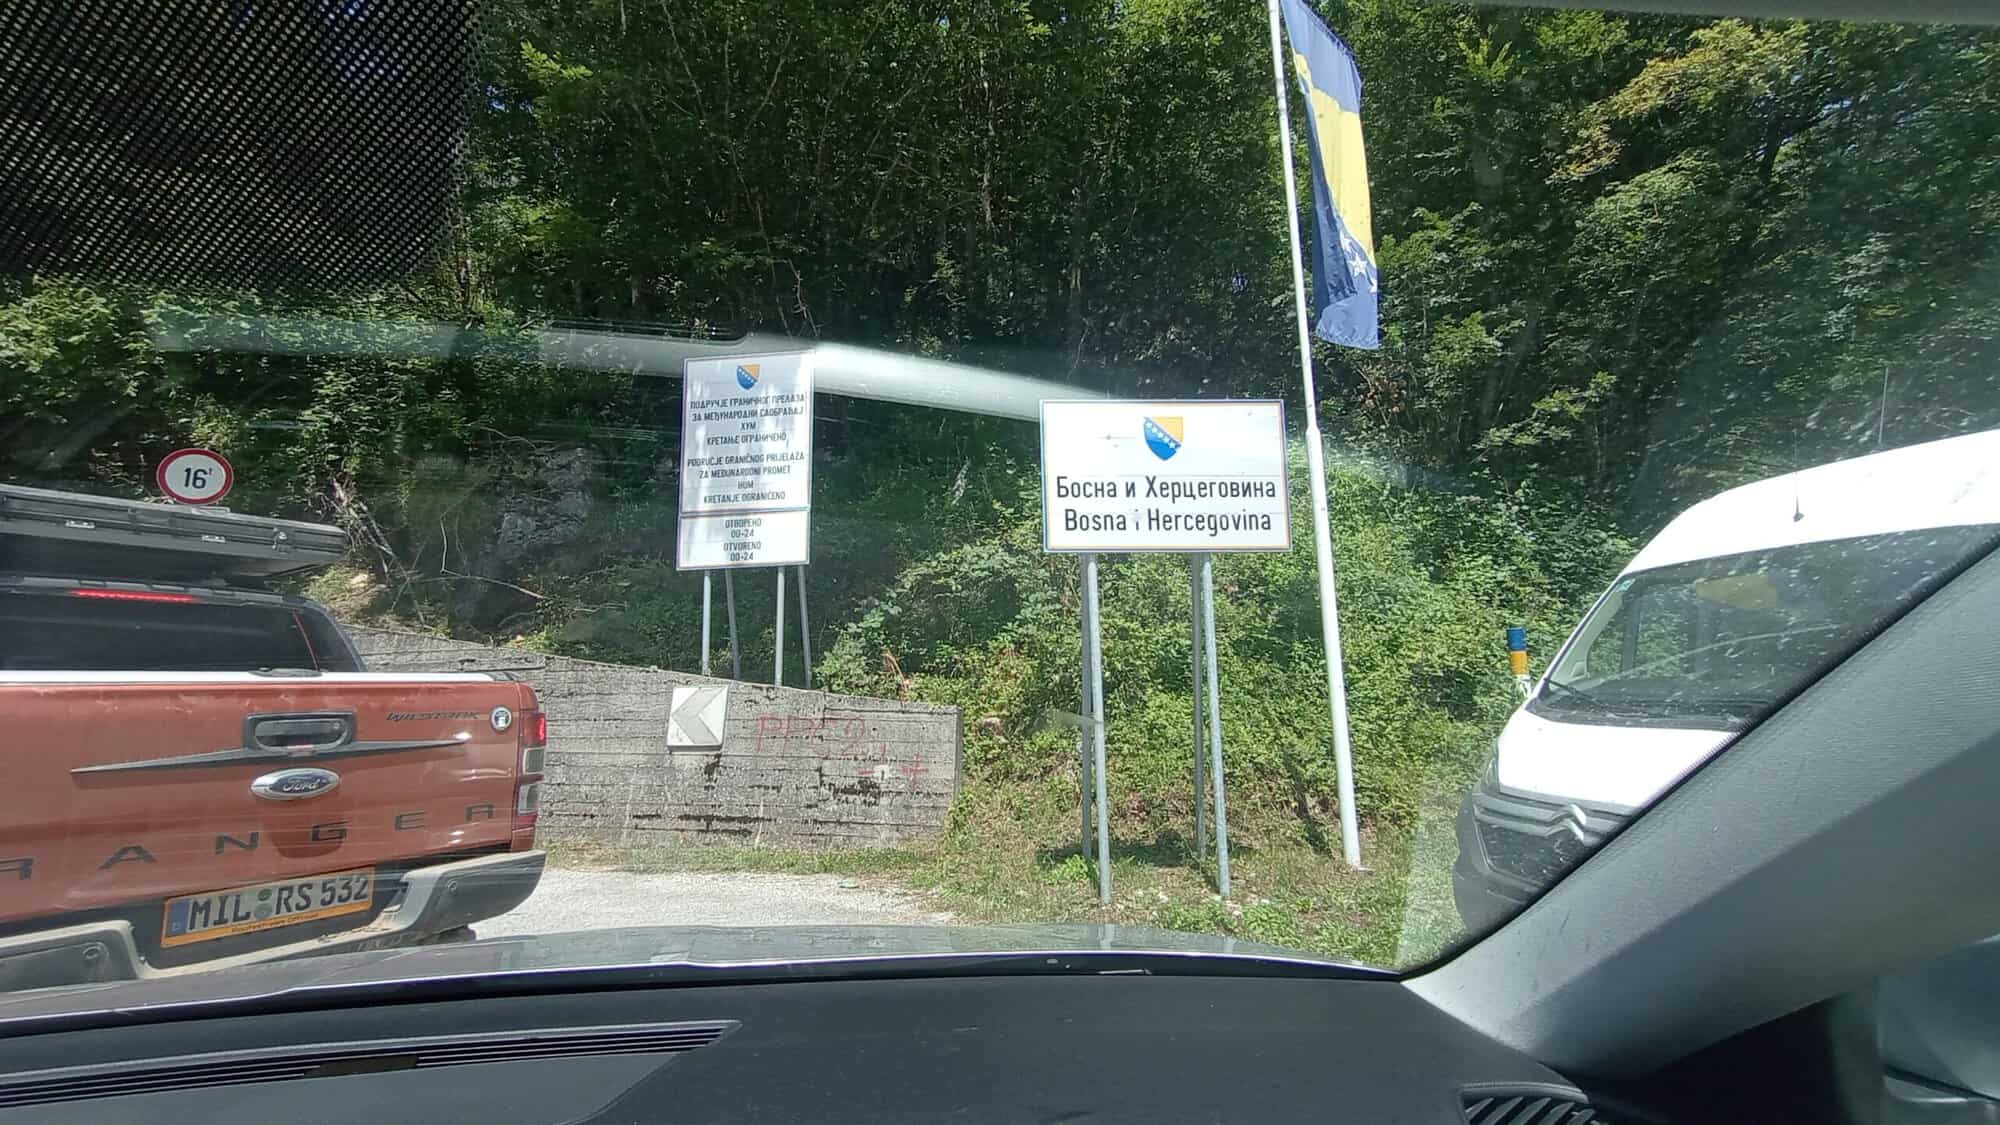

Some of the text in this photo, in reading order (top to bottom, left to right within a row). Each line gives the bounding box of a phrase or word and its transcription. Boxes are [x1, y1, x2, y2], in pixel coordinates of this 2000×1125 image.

[691, 413, 702, 422] ЗА
[741, 422, 756, 430] ХУМ
[699, 470, 709, 479] ZA
[763, 465, 791, 475] PROMET
[738, 480, 754, 489] HUM
[1056, 475, 1276, 504] Босна и Херцеговина
[704, 494, 740, 504] KRETANJE
[1064, 508, 1127, 531] Bosna
[1147, 508, 1272, 536] Hercegovina
[731, 529, 754, 538] 00-24
[730, 552, 754, 561] 00-24
[189, 894, 251, 930] MIL
[275, 883, 313, 915] RS
[320, 875, 368, 906] 532
